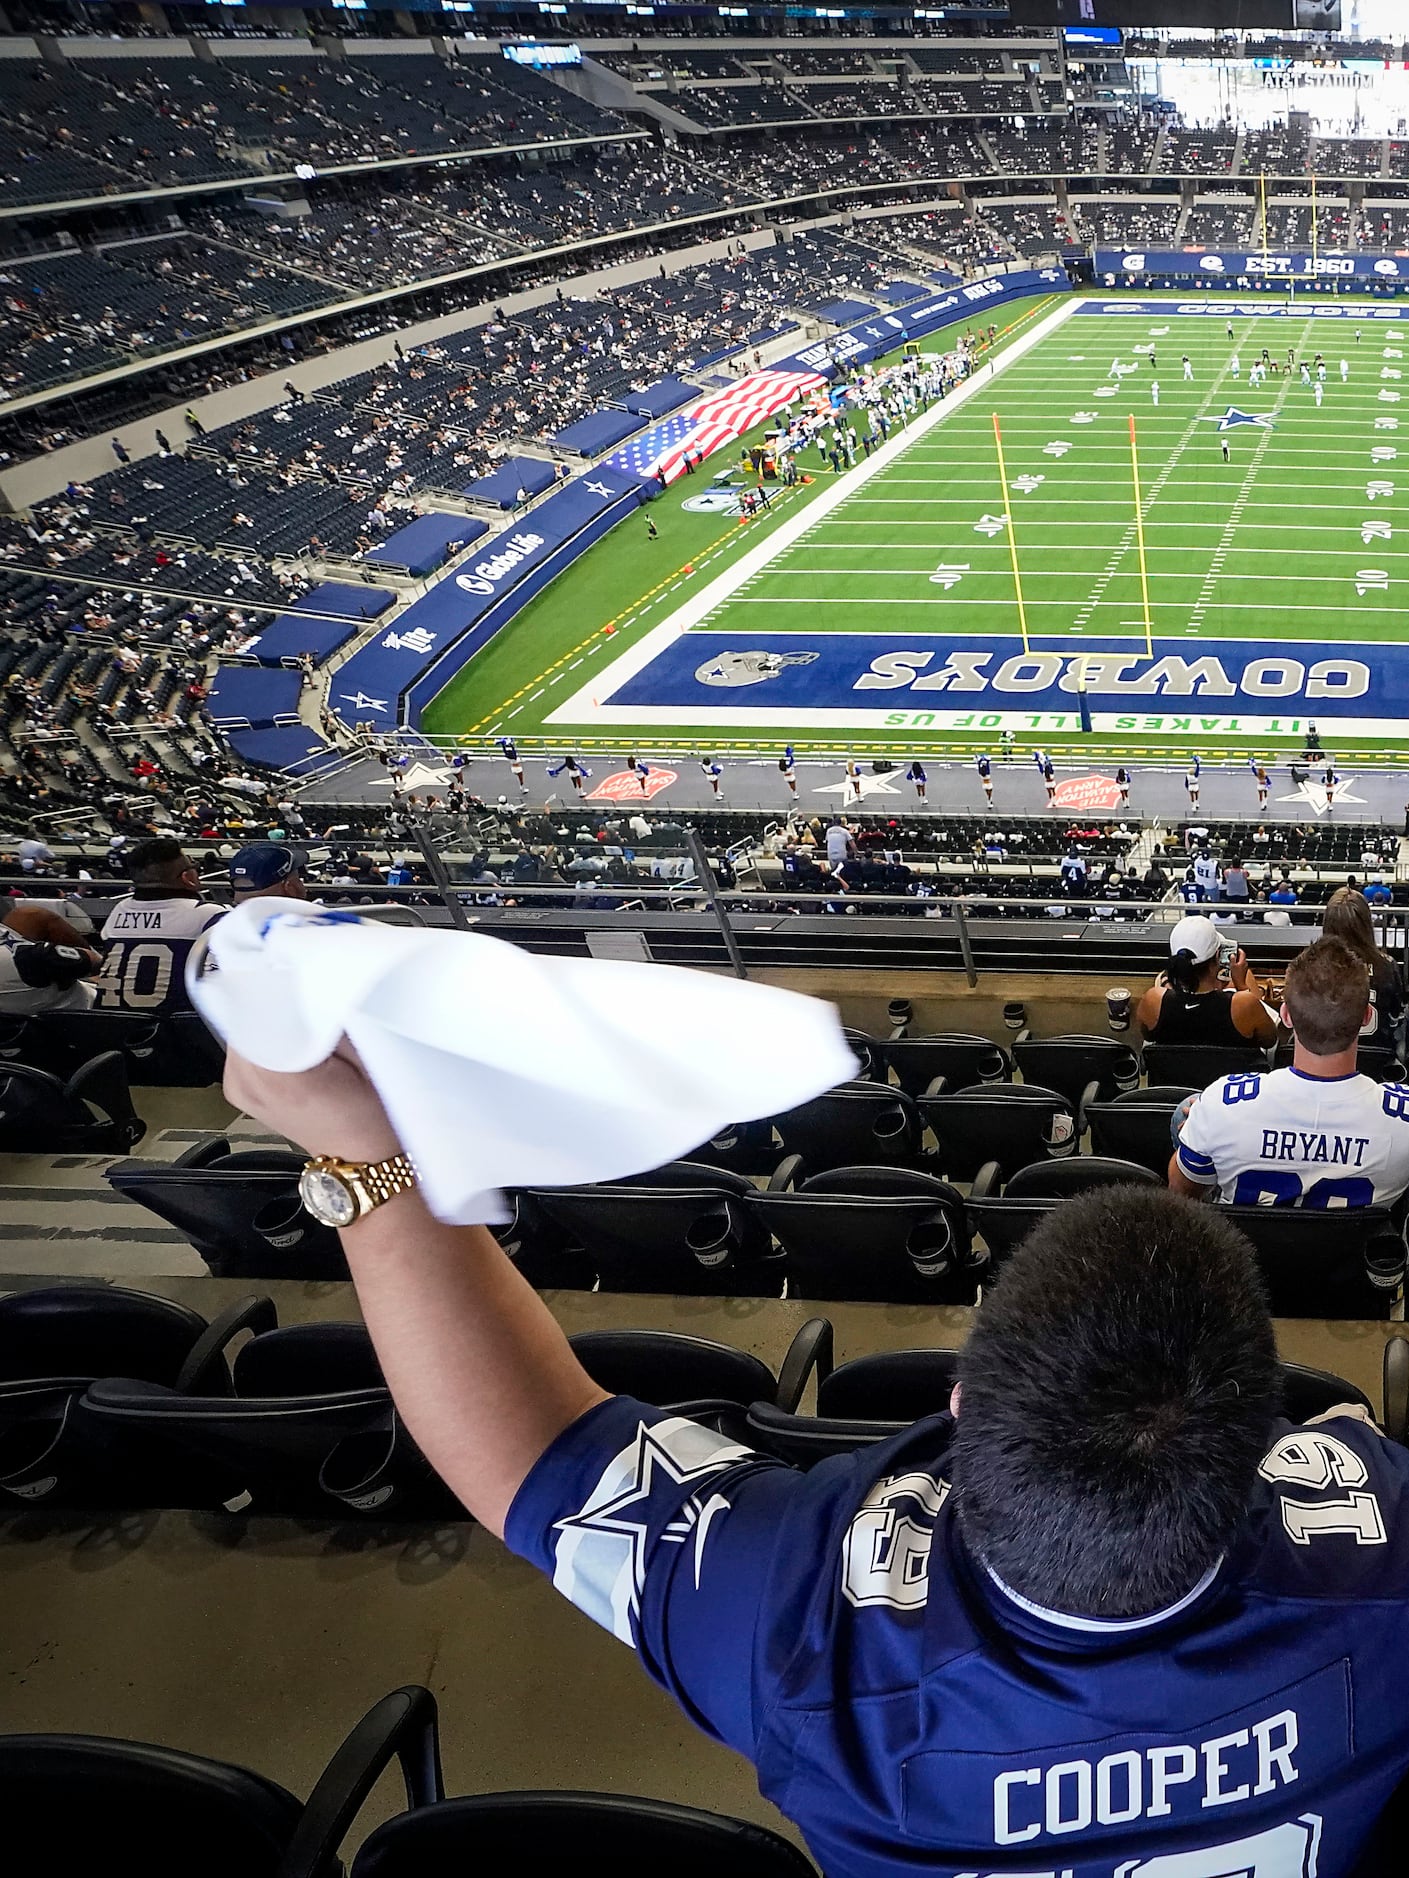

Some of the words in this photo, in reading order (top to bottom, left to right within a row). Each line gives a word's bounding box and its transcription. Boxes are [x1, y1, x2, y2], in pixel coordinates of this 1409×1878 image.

[1303, 71, 1374, 89] STADIUM
[1245, 257, 1295, 273] EST.
[1303, 258, 1355, 275] 1960
[1366, 480, 1395, 497] 30
[1361, 520, 1392, 539] 20
[474, 548, 525, 581] Globe
[505, 532, 545, 556] Life
[928, 562, 970, 584] 10
[1354, 569, 1389, 590] 10
[852, 650, 1371, 699] COWBOYS
[884, 713, 936, 726] US
[953, 715, 1003, 727] OF
[1114, 717, 1243, 731] TAKES
[1264, 720, 1301, 732] IT
[1062, 779, 1105, 795] ARMY
[1067, 867, 1079, 881] 4
[113, 912, 162, 929] LEYVA
[99, 942, 174, 1008] 40
[126, 1125, 139, 1140] 2
[1260, 1129, 1369, 1167] BRYANT
[993, 1709, 1300, 1846] COOPER
